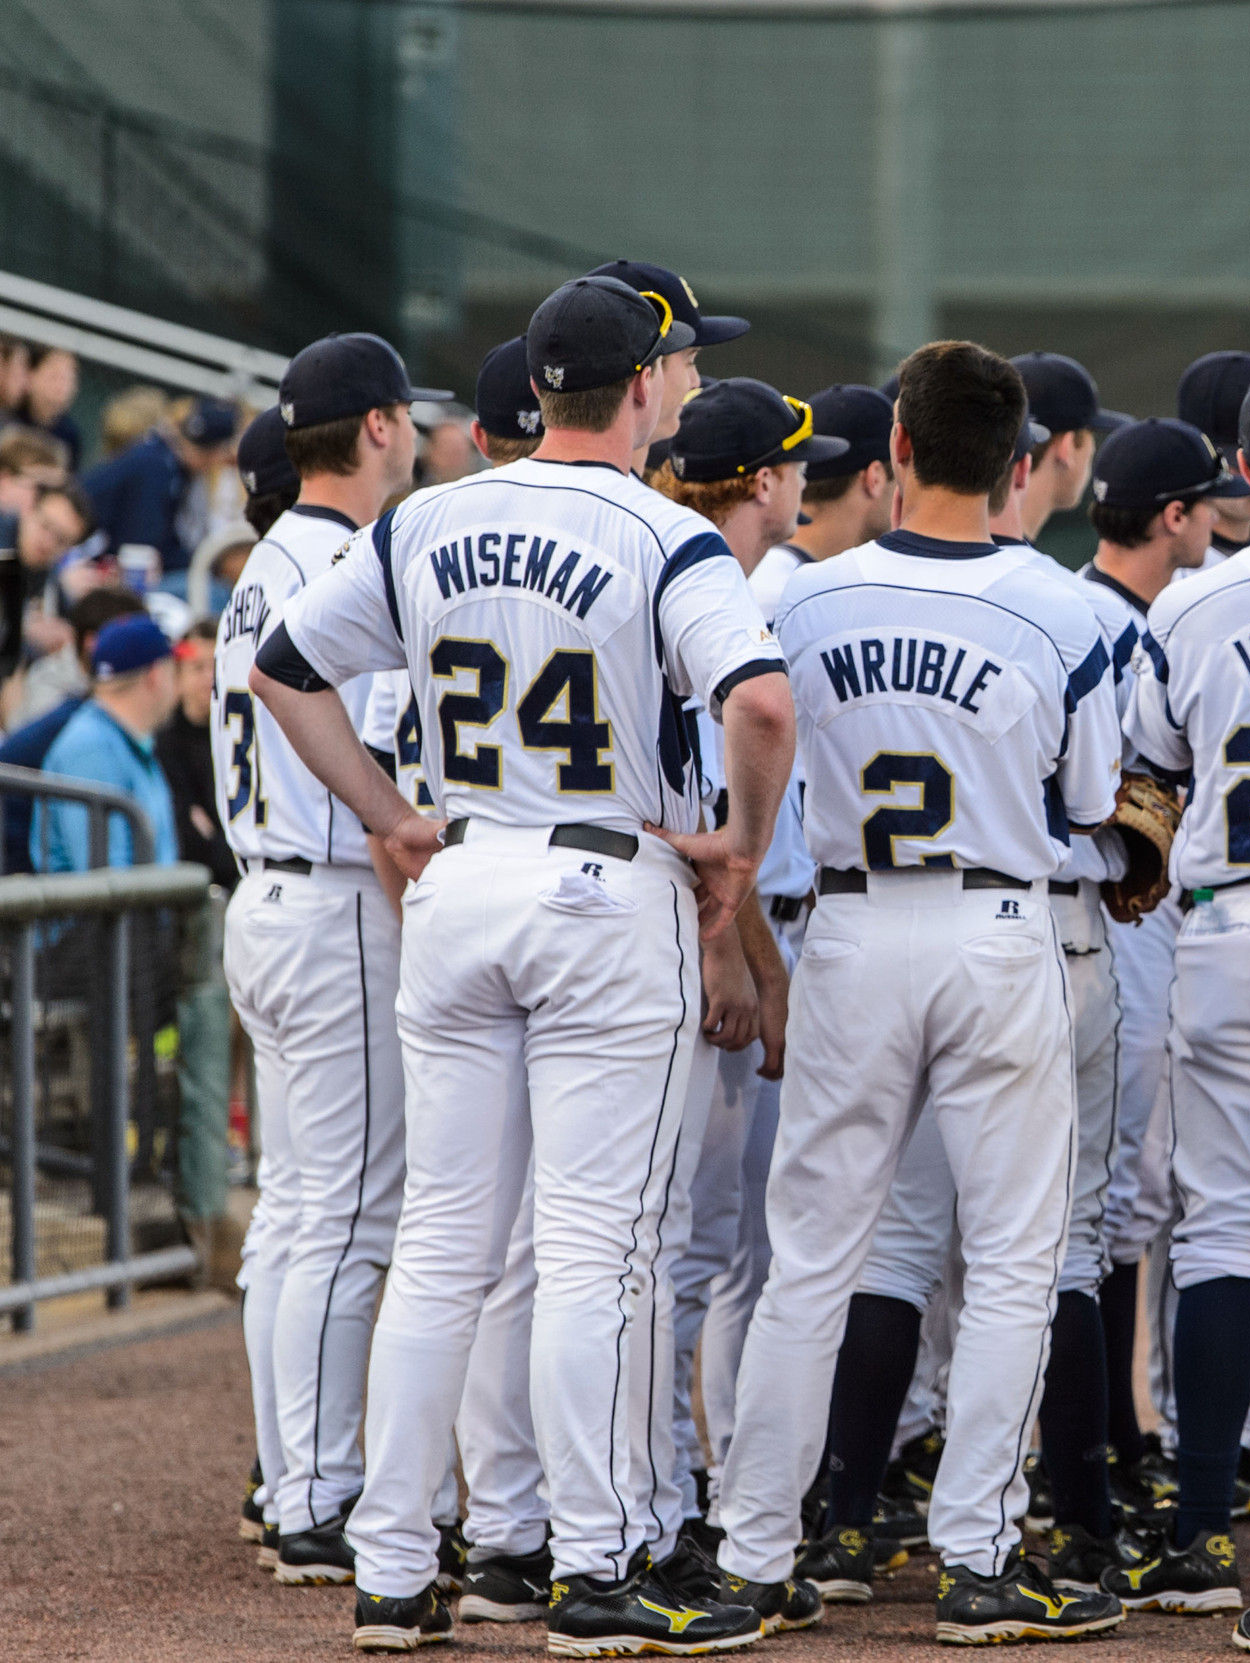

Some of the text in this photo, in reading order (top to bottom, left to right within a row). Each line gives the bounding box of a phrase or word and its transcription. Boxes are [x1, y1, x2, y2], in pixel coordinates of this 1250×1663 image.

[429, 532, 614, 621] WISEMAN
[429, 635, 617, 796] 24
[819, 637, 1003, 716] WRUBLE
[859, 749, 956, 872] 2
